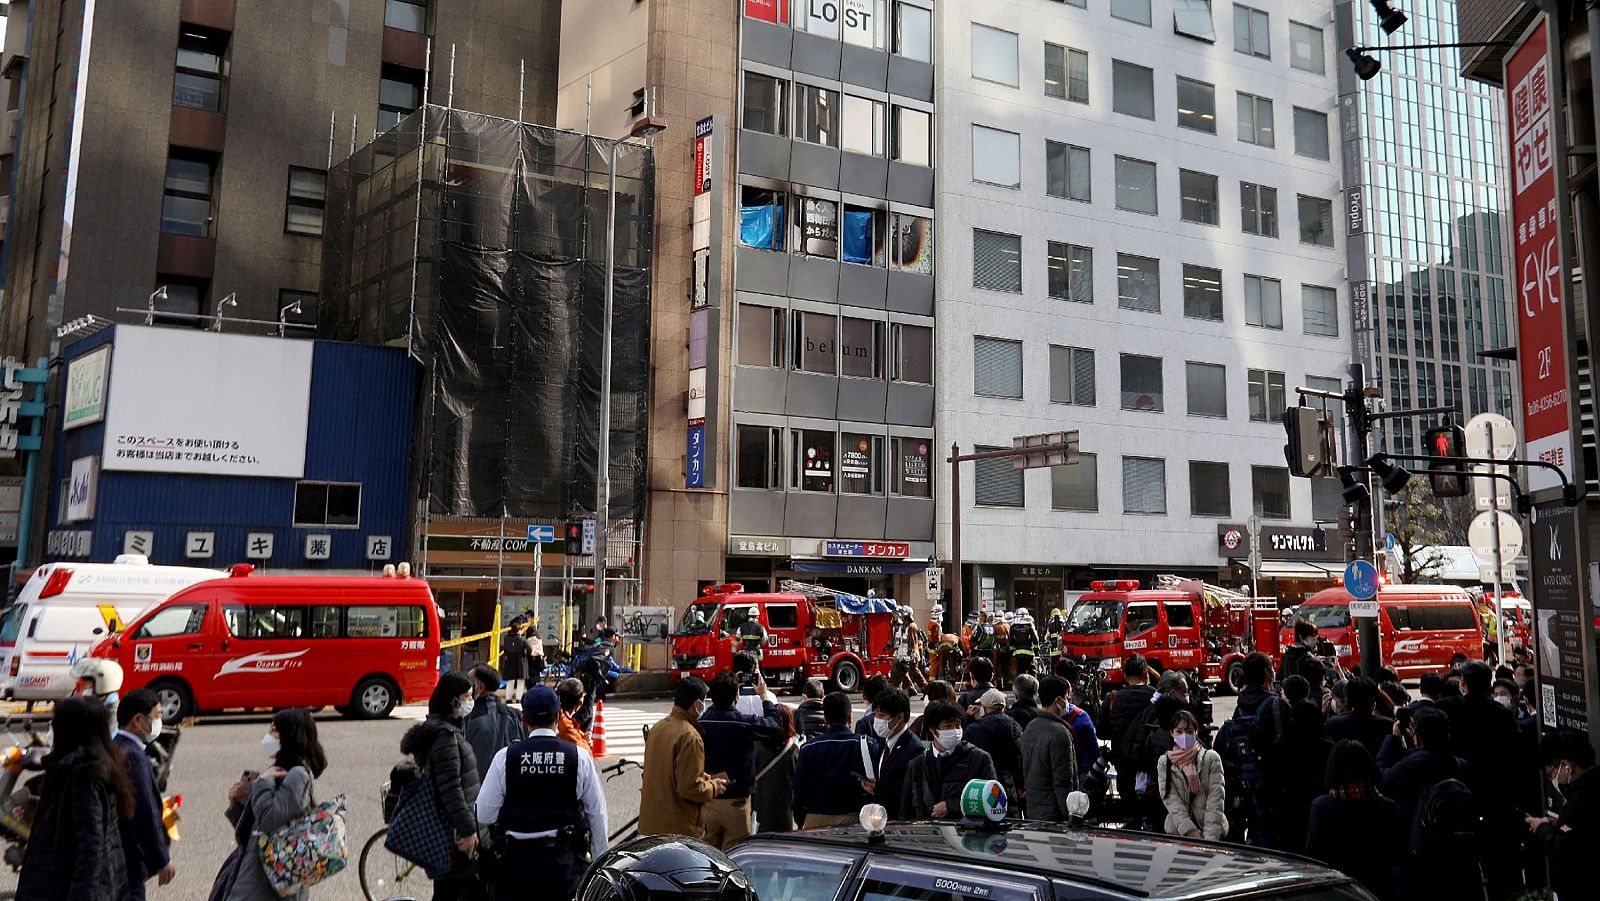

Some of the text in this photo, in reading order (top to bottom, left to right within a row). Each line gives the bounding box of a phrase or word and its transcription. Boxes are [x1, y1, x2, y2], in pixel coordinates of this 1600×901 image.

[810, 0, 871, 31] LOST
[1515, 64, 1547, 134] 健康
[1518, 120, 1549, 186] やせ
[1538, 346, 1551, 380] 2F
[117, 435, 240, 450] このスペースをお使い頂ける
[116, 449, 261, 464] お客様は当店までお越しください。
[692, 430, 701, 485] ダンカン
[1271, 534, 1327, 551] サンマルクカ
[867, 545, 907, 557] ダンカン
[847, 565, 882, 574] DANKAN
[256, 659, 303, 668] Osaka Fire
[520, 751, 565, 766] 大阪府警
[520, 765, 565, 775] POLICE
